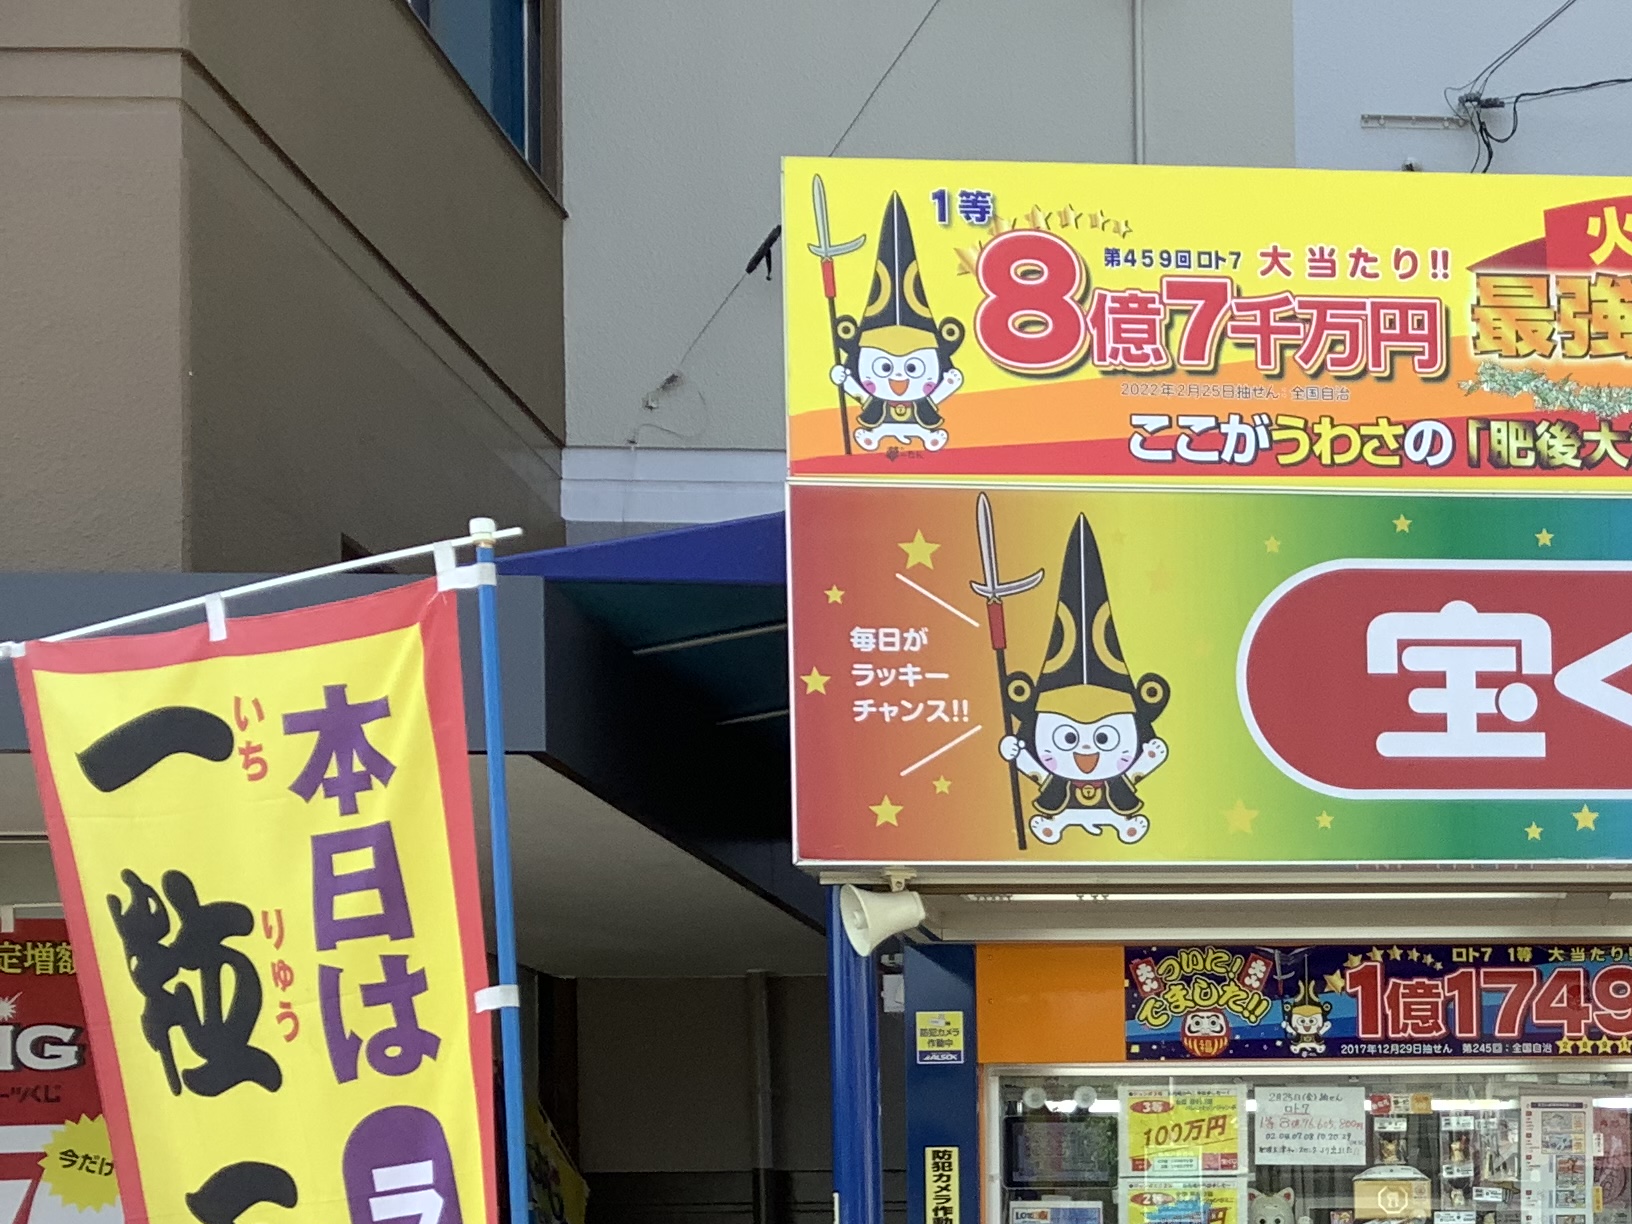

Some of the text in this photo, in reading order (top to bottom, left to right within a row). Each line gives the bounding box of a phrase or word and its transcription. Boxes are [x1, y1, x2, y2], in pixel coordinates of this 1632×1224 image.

[929, 188, 993, 225] 1等
[1257, 246, 1451, 281] 大当たり!!
[974, 229, 1450, 376] 8億7千万円
[850, 626, 928, 651] 毎日が
[851, 664, 949, 687] ラッキー
[852, 699, 969, 723] チャンス!!
[233, 695, 269, 782] いち
[282, 684, 442, 1084] 本日は
[260, 908, 300, 1042] りゅう
